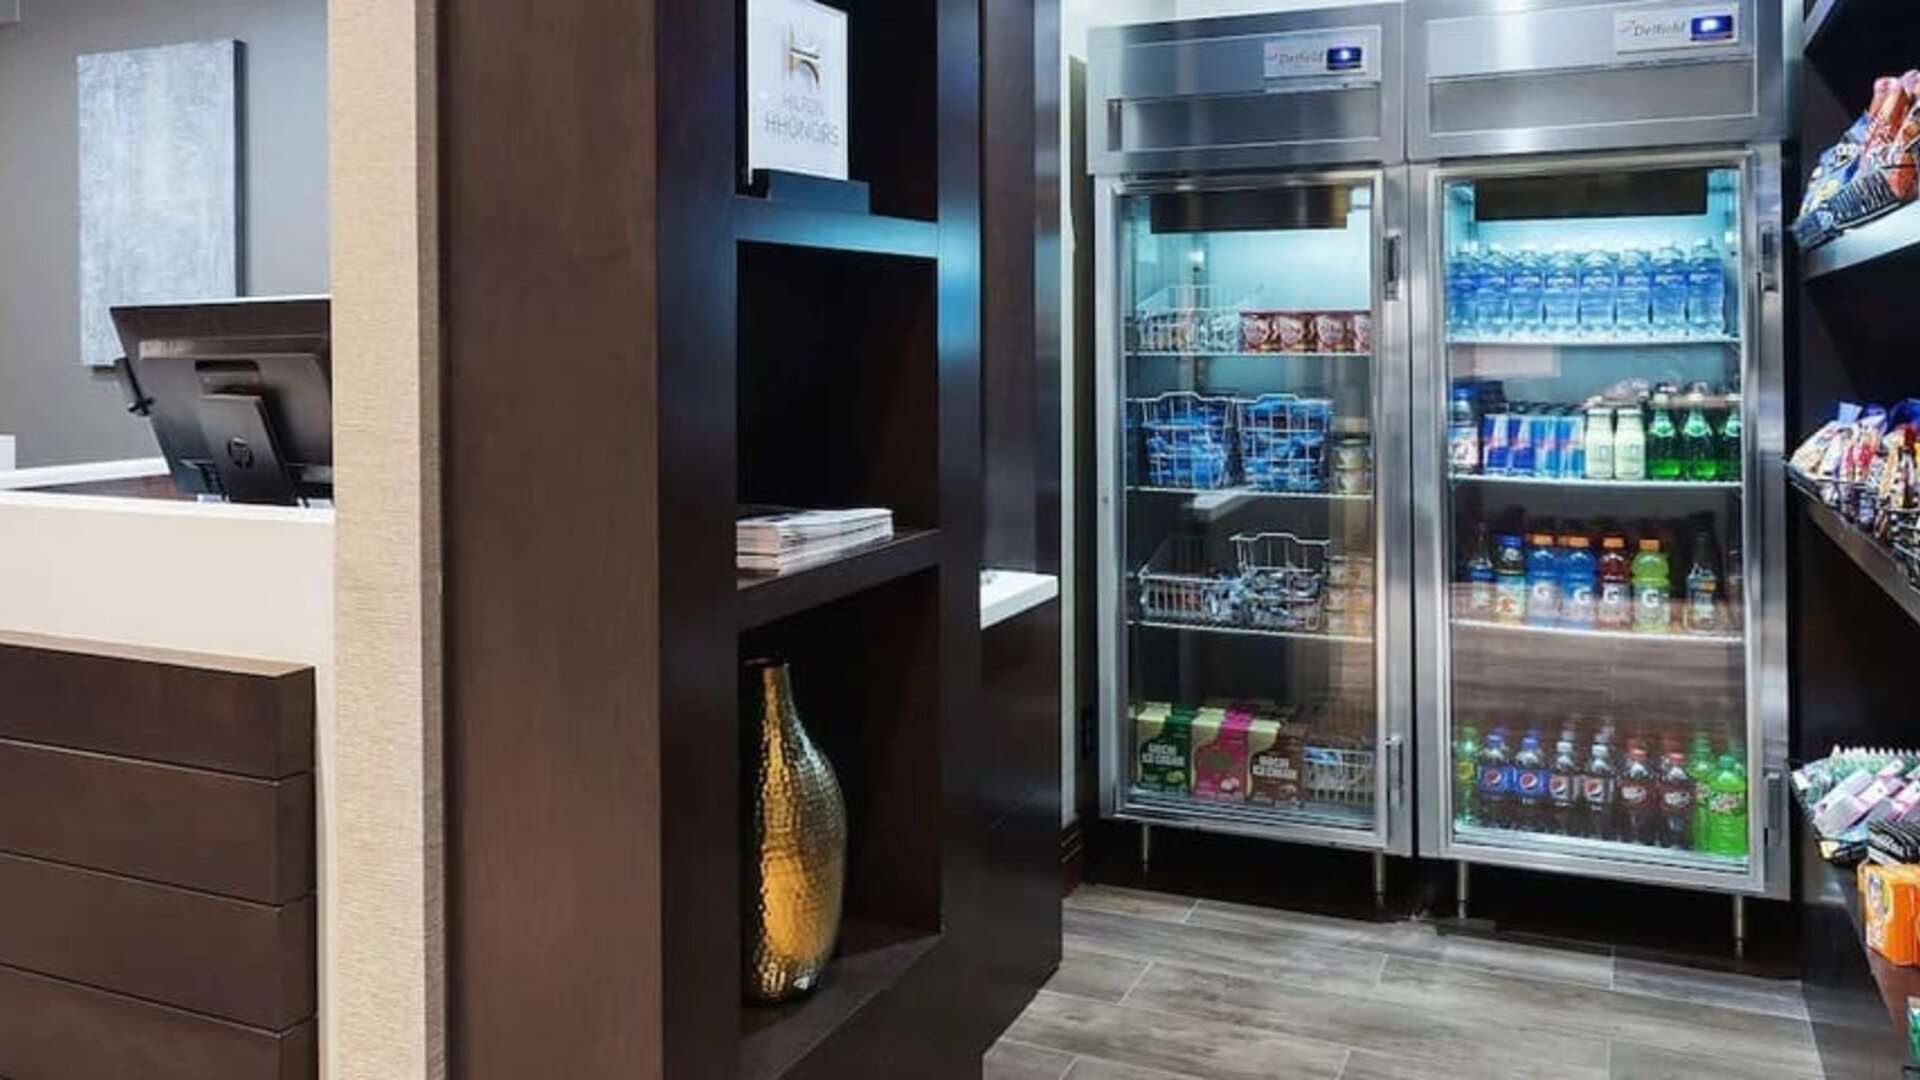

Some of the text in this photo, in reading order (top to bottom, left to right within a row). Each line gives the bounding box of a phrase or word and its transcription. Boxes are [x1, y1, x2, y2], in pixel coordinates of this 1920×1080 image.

[1573, 585, 1591, 604] G
[1603, 584, 1620, 604] G
[1641, 588, 1659, 608] G
